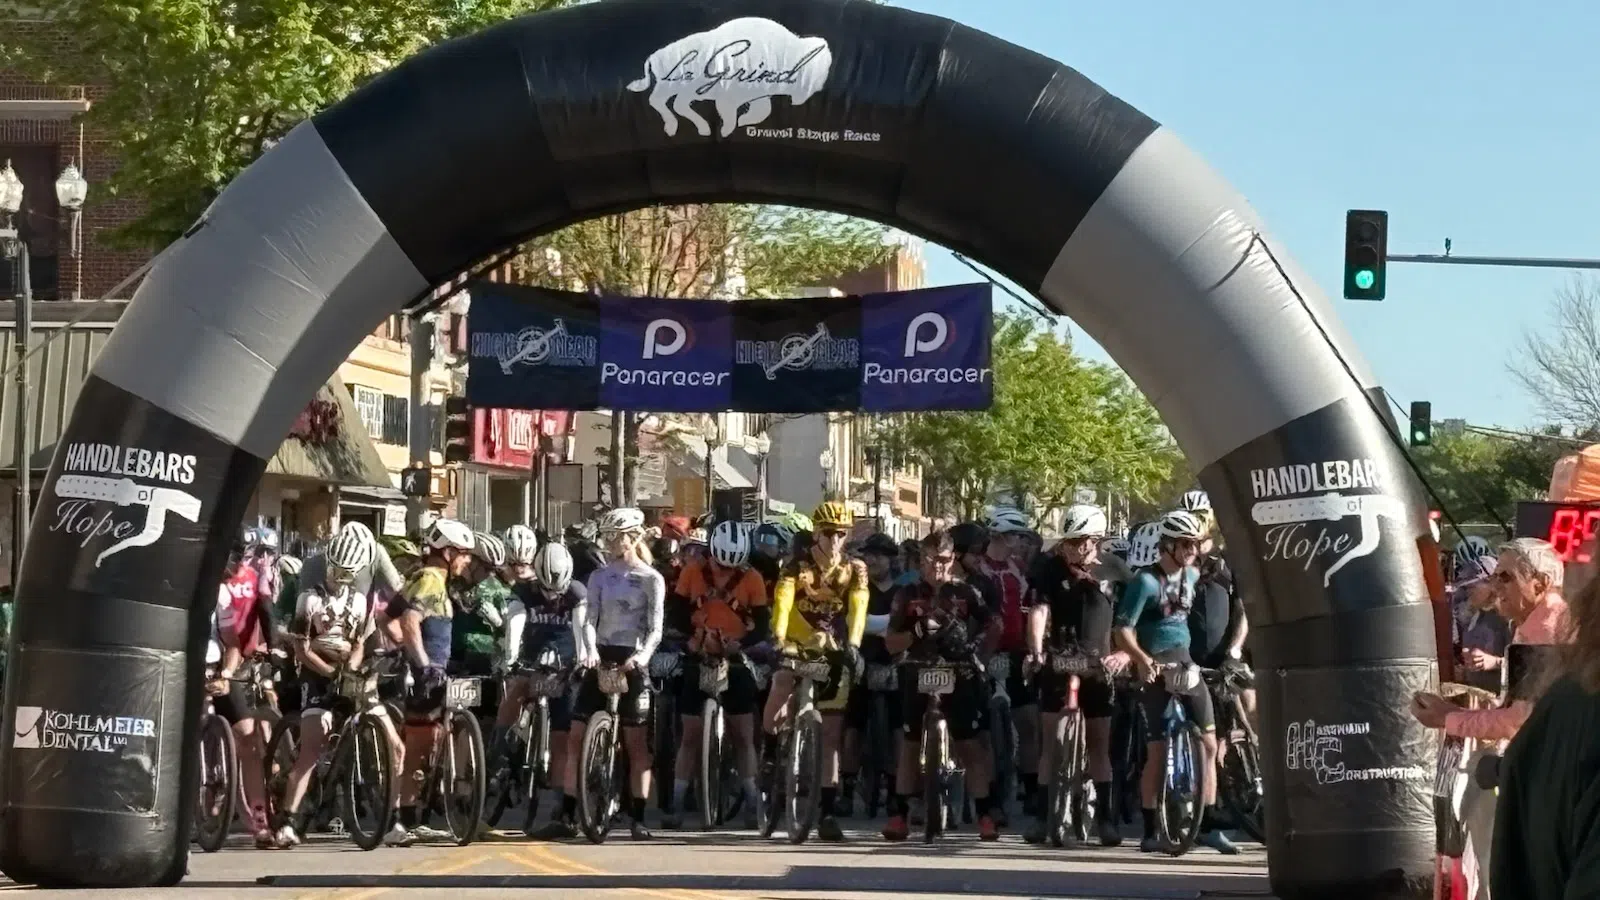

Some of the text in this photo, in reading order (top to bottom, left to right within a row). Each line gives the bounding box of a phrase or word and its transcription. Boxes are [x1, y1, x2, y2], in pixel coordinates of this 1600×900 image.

[695, 39, 825, 95] Grind
[600, 362, 730, 387] Panaracer
[863, 362, 993, 385] Panaracer
[63, 443, 197, 485] HANDLEBARS
[1250, 458, 1382, 499] HANDLEBAR
[49, 500, 135, 548] Hope
[1263, 523, 1354, 571] Hope
[41, 729, 115, 752] DENTAL
[44, 709, 156, 737] KOHLMEIER
